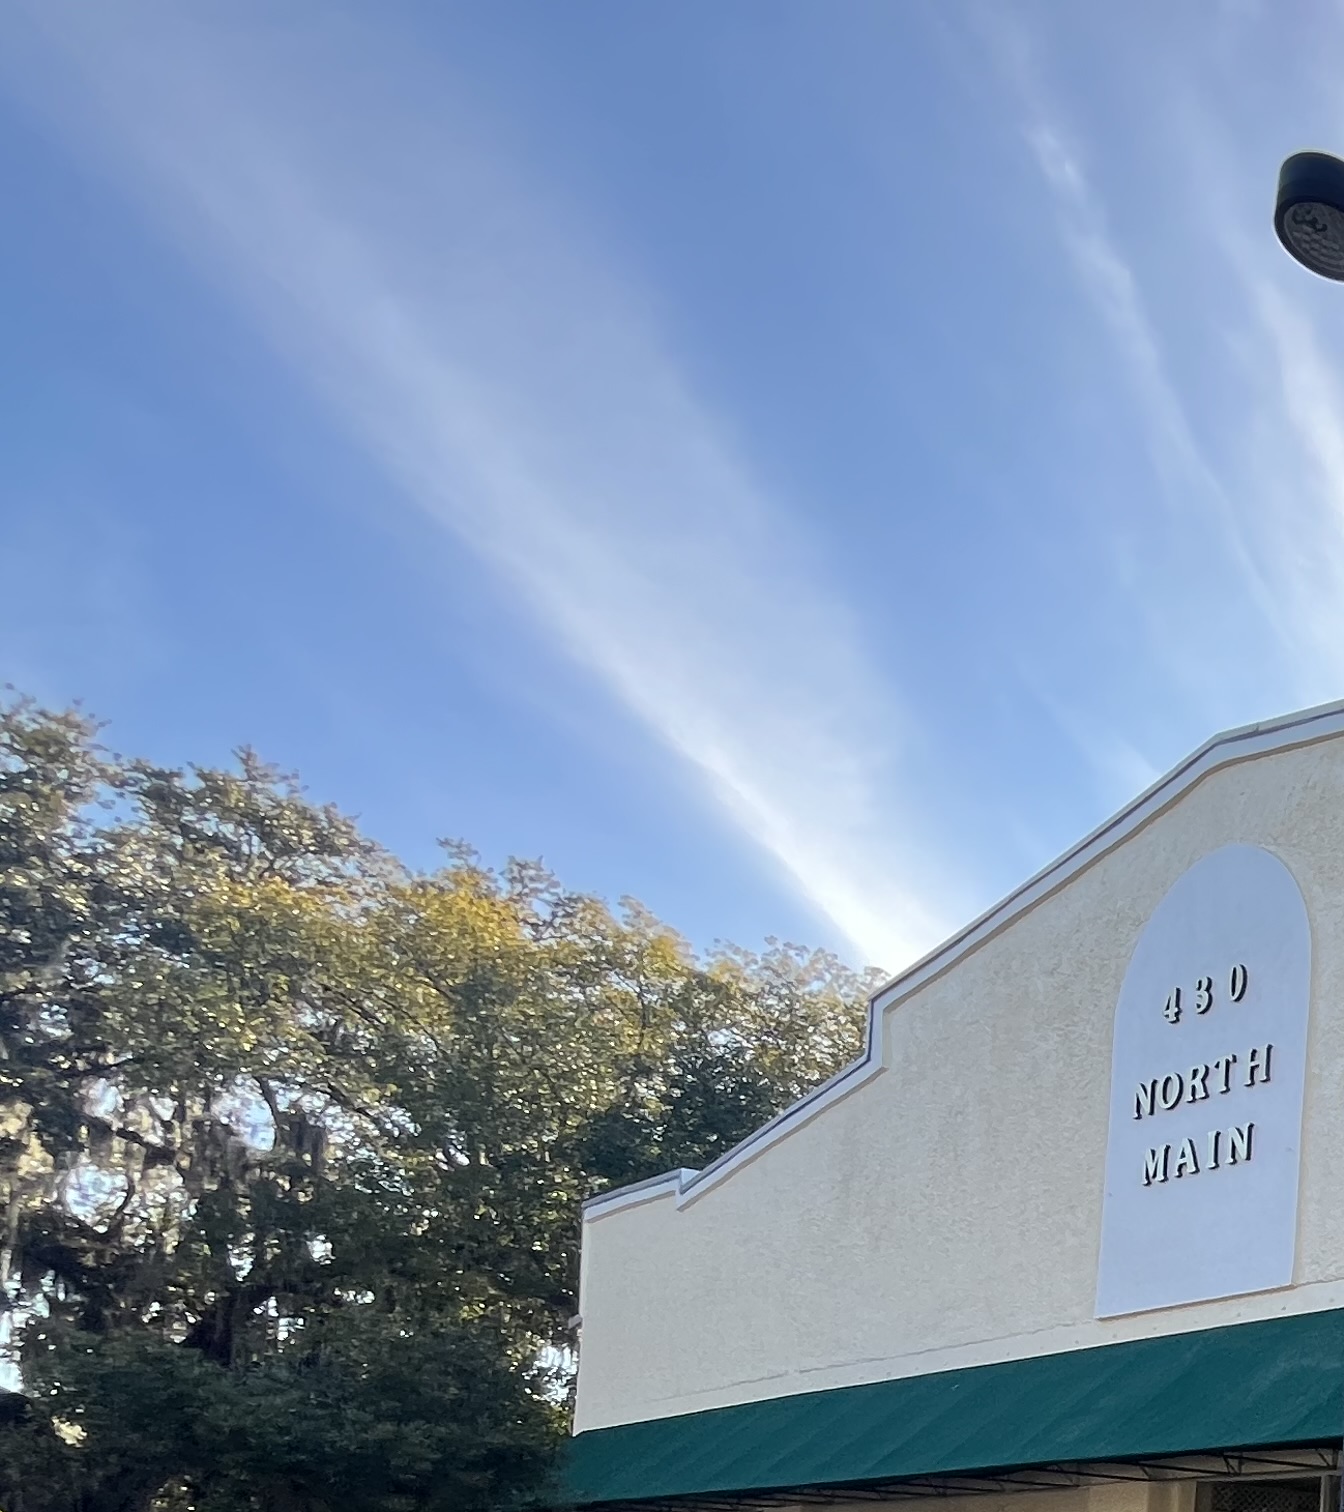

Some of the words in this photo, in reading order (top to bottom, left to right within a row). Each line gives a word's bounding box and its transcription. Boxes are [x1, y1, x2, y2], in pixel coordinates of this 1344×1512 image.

[1163, 964, 1248, 1023] 430
[1133, 1044, 1273, 1119] NORTH
[1142, 1122, 1255, 1186] MAIN
